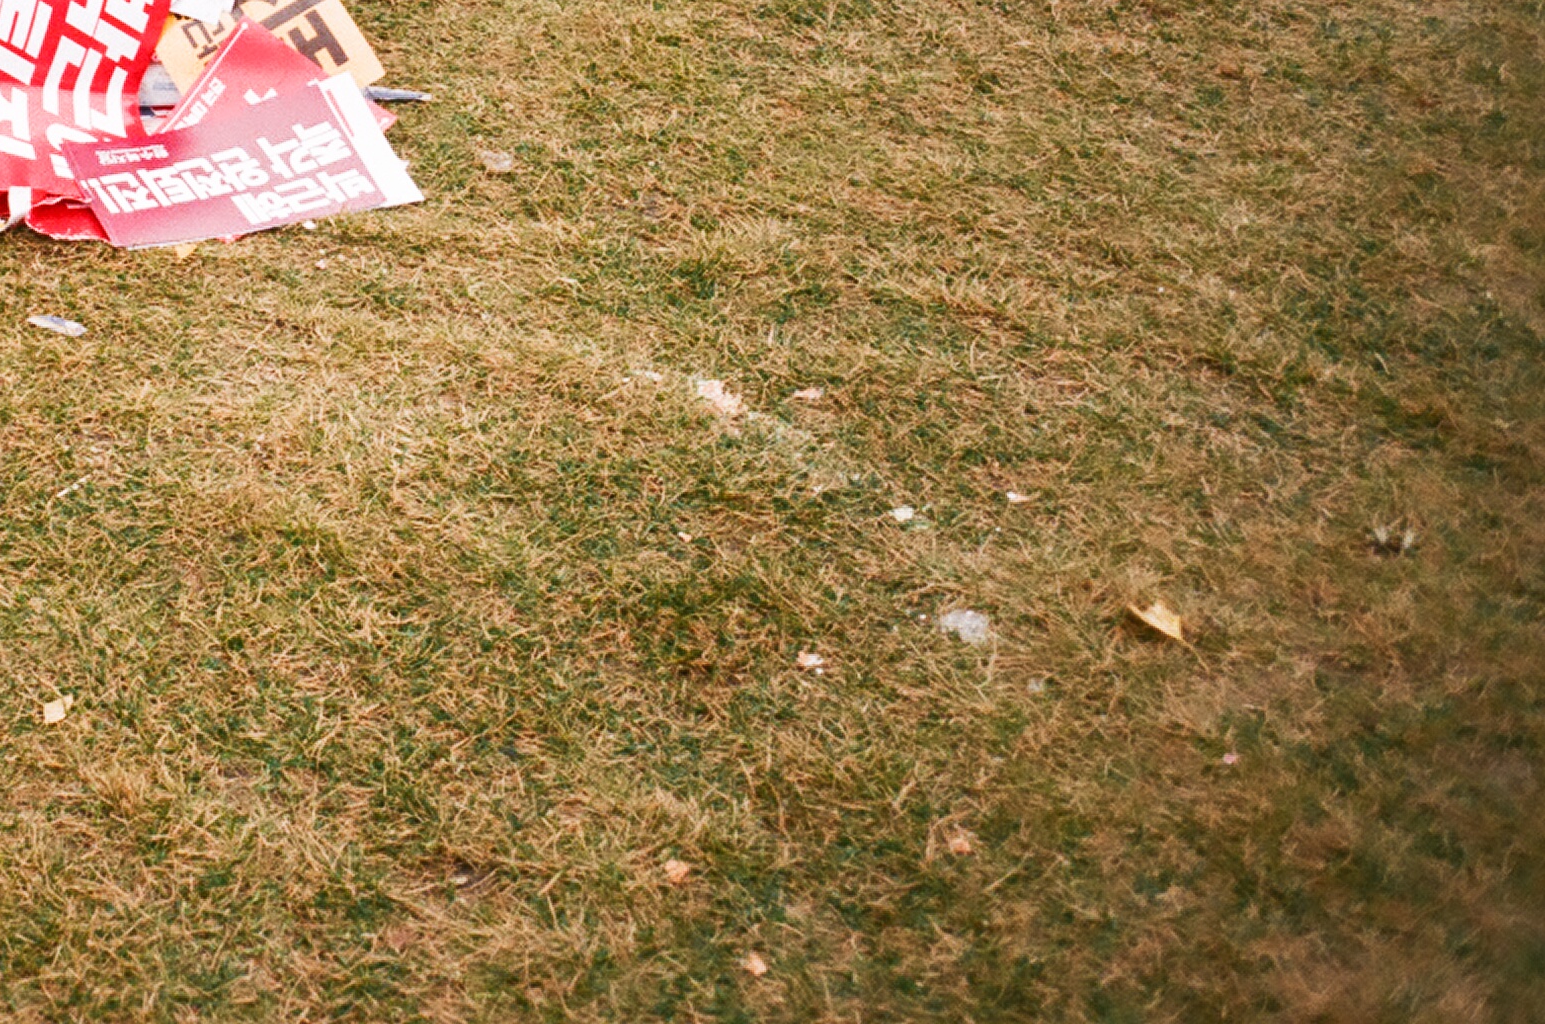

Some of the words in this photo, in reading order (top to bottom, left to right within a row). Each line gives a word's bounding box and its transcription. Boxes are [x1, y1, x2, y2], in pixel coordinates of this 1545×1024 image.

[256, 122, 352, 176] 즉각
[81, 147, 270, 214] 완전퇴진!
[230, 168, 375, 225] 박근혜
